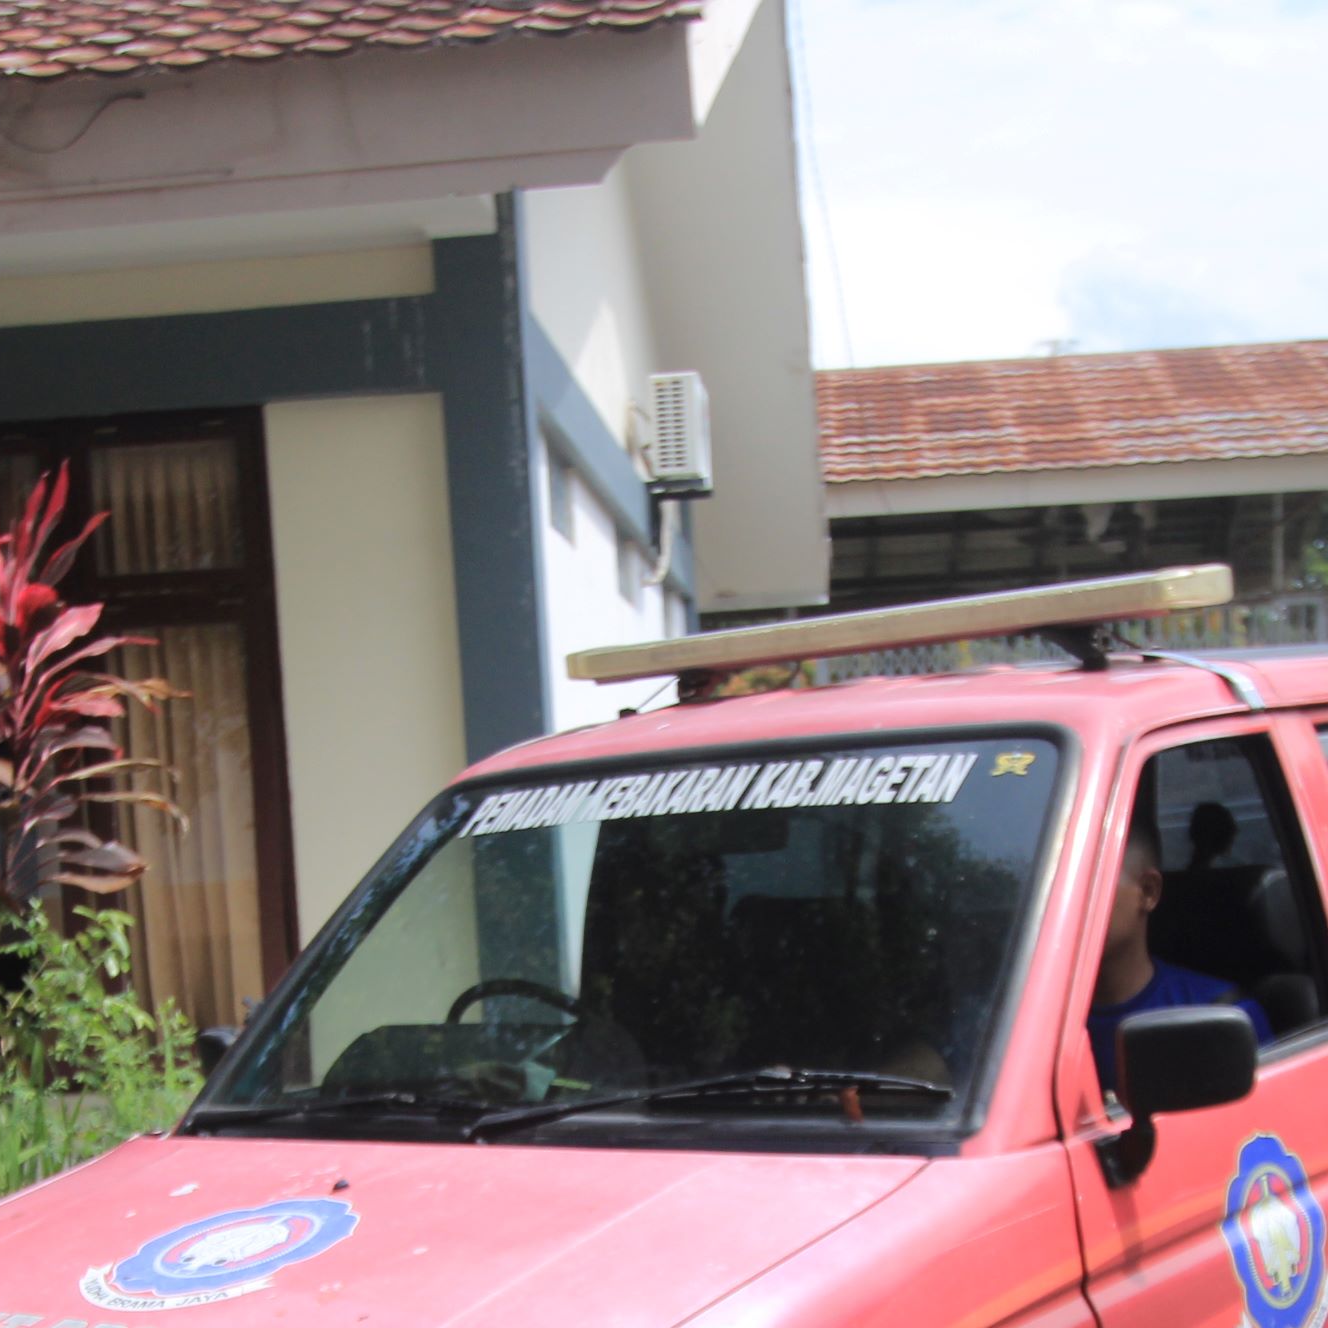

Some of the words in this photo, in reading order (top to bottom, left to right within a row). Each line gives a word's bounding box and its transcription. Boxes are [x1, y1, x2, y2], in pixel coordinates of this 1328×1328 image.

[459, 780, 598, 839] PEMADAM
[582, 763, 761, 824] KEBAKARAN
[175, 1291, 230, 1307] JAYA
